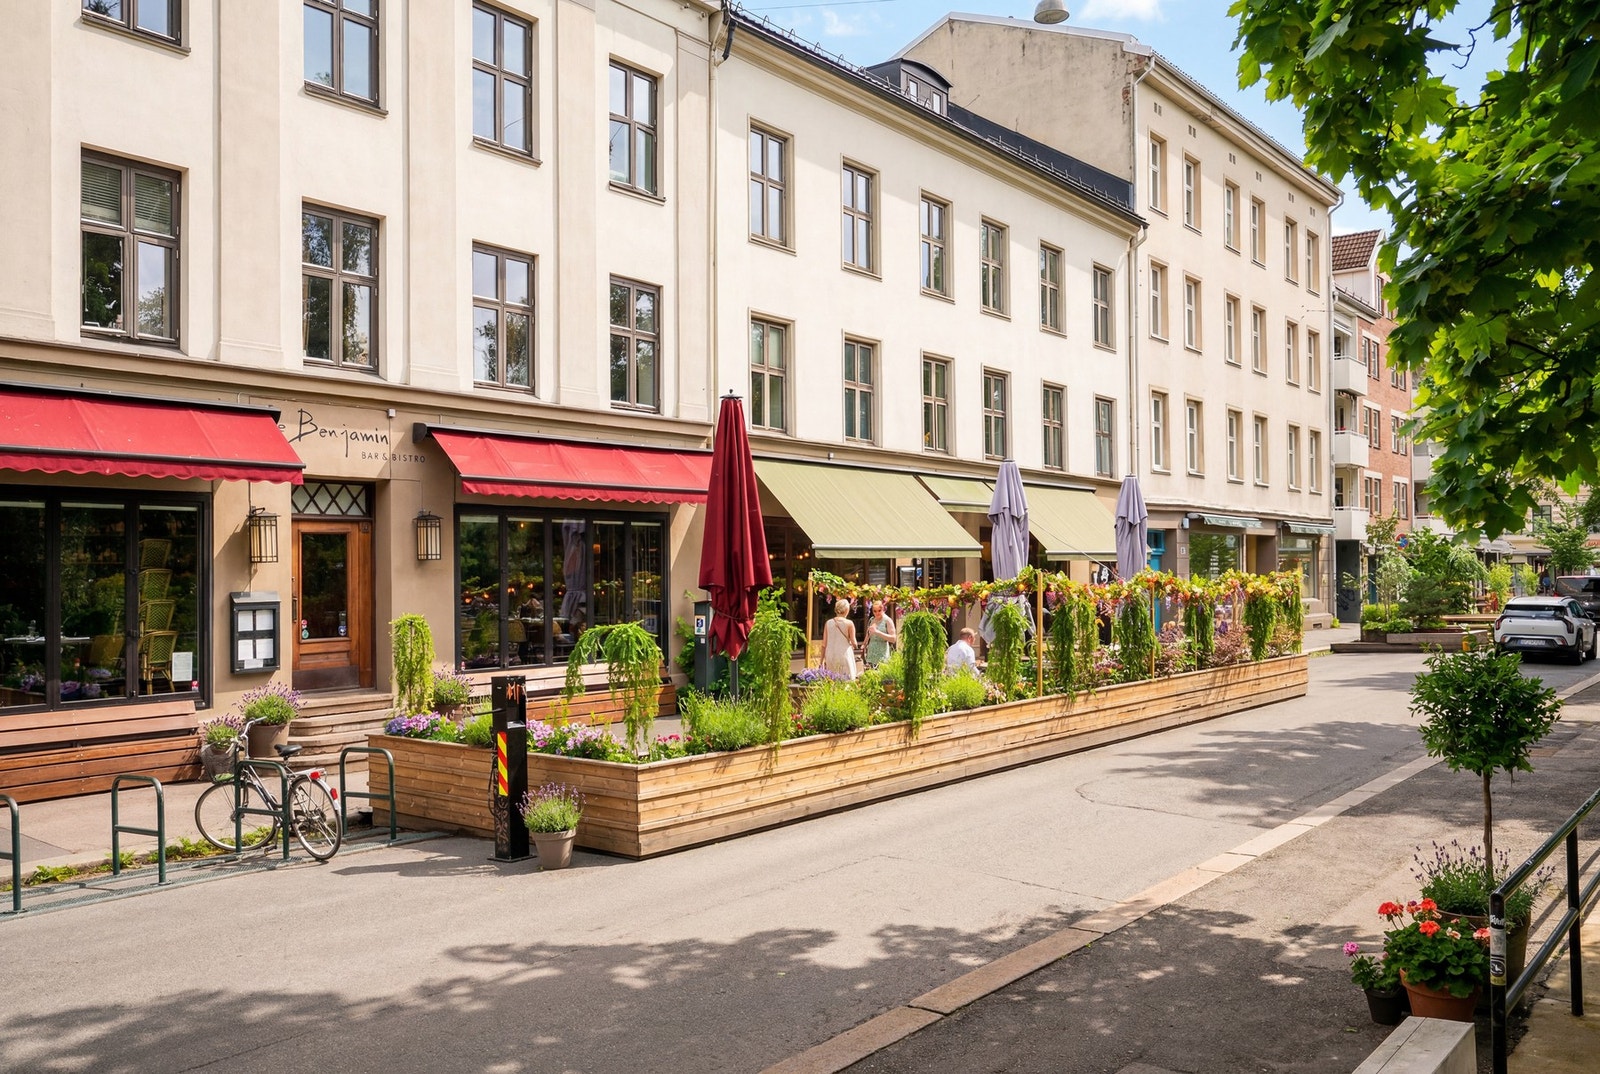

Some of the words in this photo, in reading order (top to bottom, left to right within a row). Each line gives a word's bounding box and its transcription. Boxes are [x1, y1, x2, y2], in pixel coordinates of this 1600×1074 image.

[288, 408, 389, 458] Benjamin
[361, 451, 379, 460] BAR
[382, 452, 388, 461] &
[391, 453, 426, 463] BISTRO
